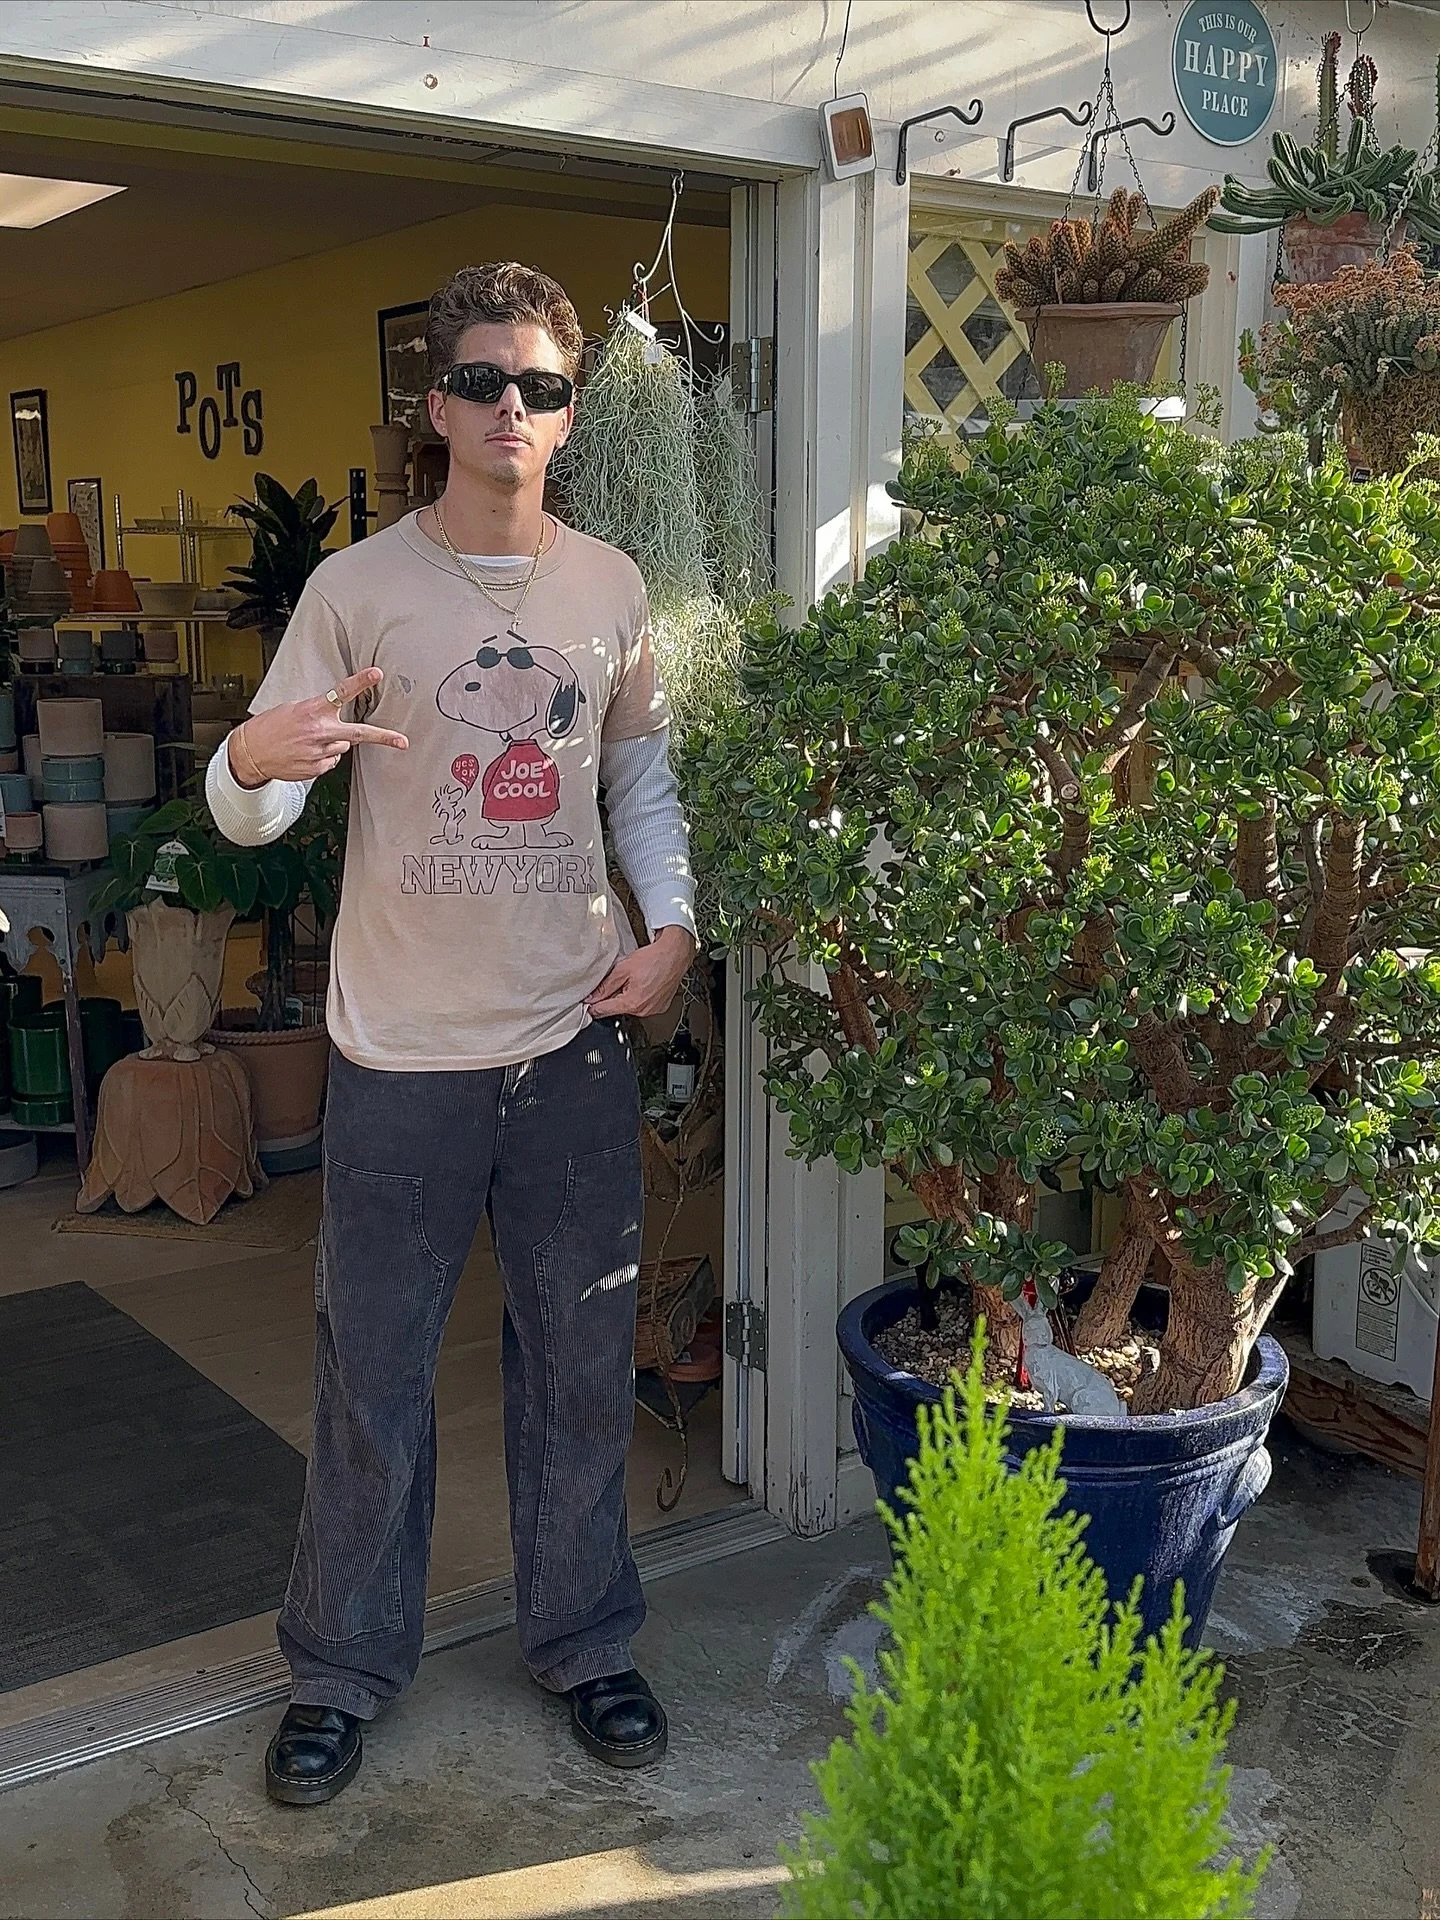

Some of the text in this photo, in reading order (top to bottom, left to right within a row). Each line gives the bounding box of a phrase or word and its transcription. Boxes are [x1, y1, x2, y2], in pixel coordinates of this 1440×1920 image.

[1199, 13, 1257, 43] THIS IS OUR
[1183, 40, 1268, 87] HAPPY
[1202, 89, 1248, 117] PLACE
[501, 760, 544, 779] JOE
[494, 781, 550, 799] COOL
